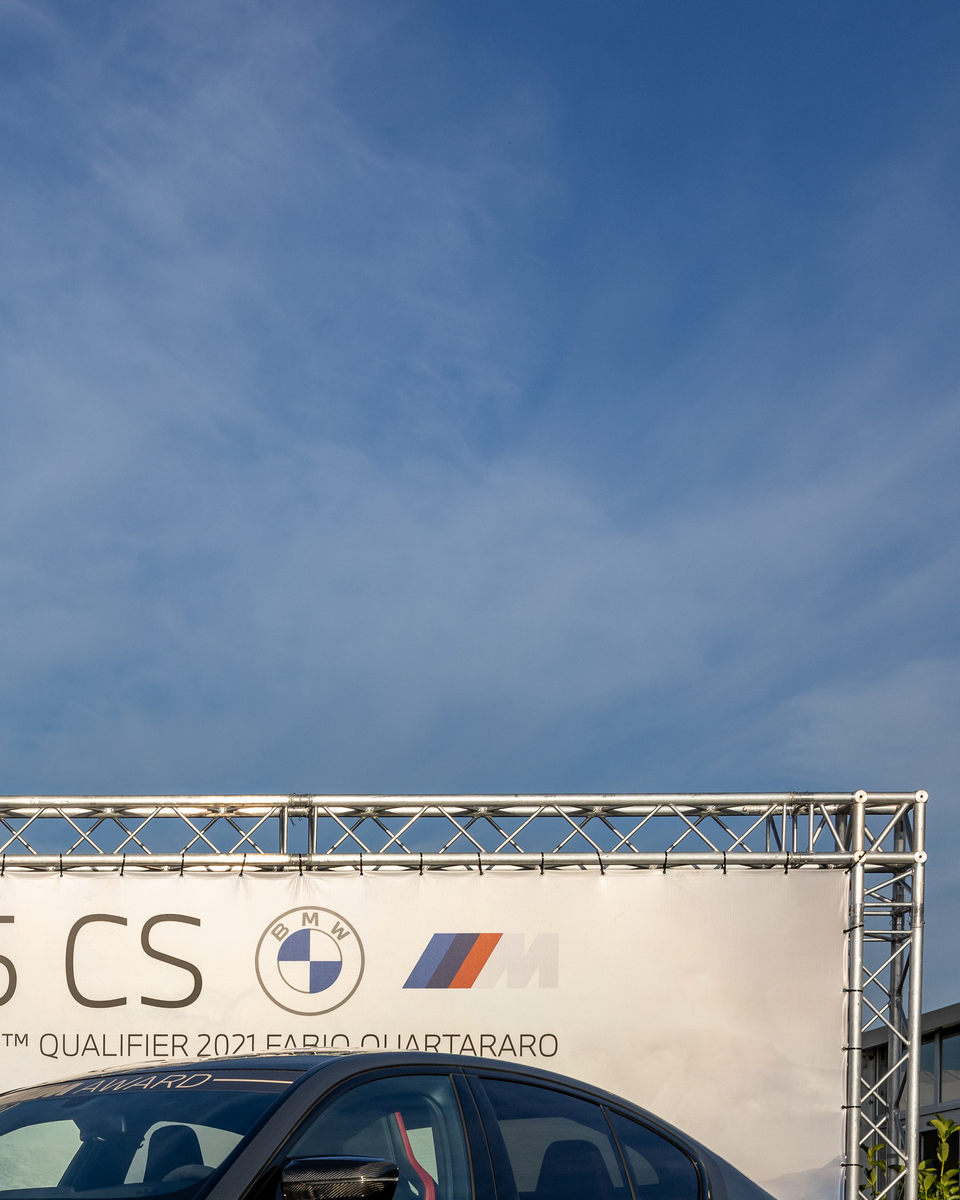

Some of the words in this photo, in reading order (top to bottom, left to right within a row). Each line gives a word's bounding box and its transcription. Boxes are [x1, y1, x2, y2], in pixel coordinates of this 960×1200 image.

[64, 913, 204, 1009] CS
[39, 1033, 189, 1059] QUALIFIER
[196, 1033, 256, 1057] 2021
[72, 1073, 213, 1095] AWARD
